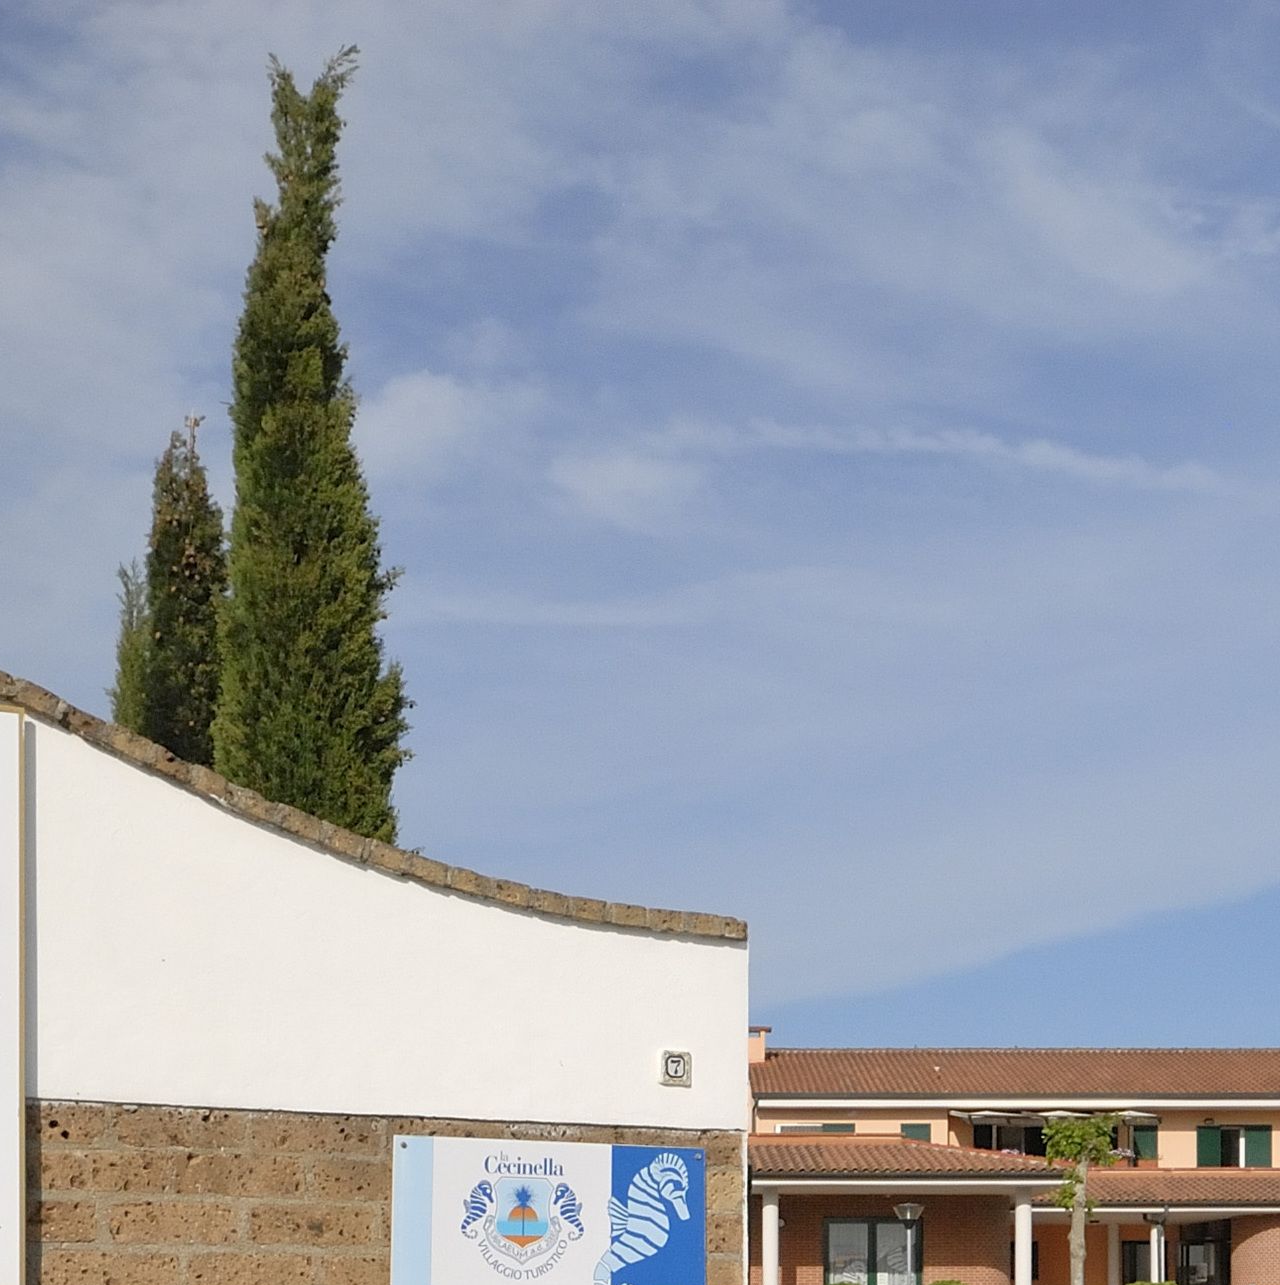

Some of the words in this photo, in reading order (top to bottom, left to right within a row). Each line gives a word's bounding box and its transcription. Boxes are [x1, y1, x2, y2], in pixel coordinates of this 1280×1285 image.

[670, 1059, 681, 1075] 7
[484, 1154, 564, 1177] Cecinella
[478, 1239, 523, 1281] VILLAGGIO
[523, 1238, 568, 1280] TURISTICO
